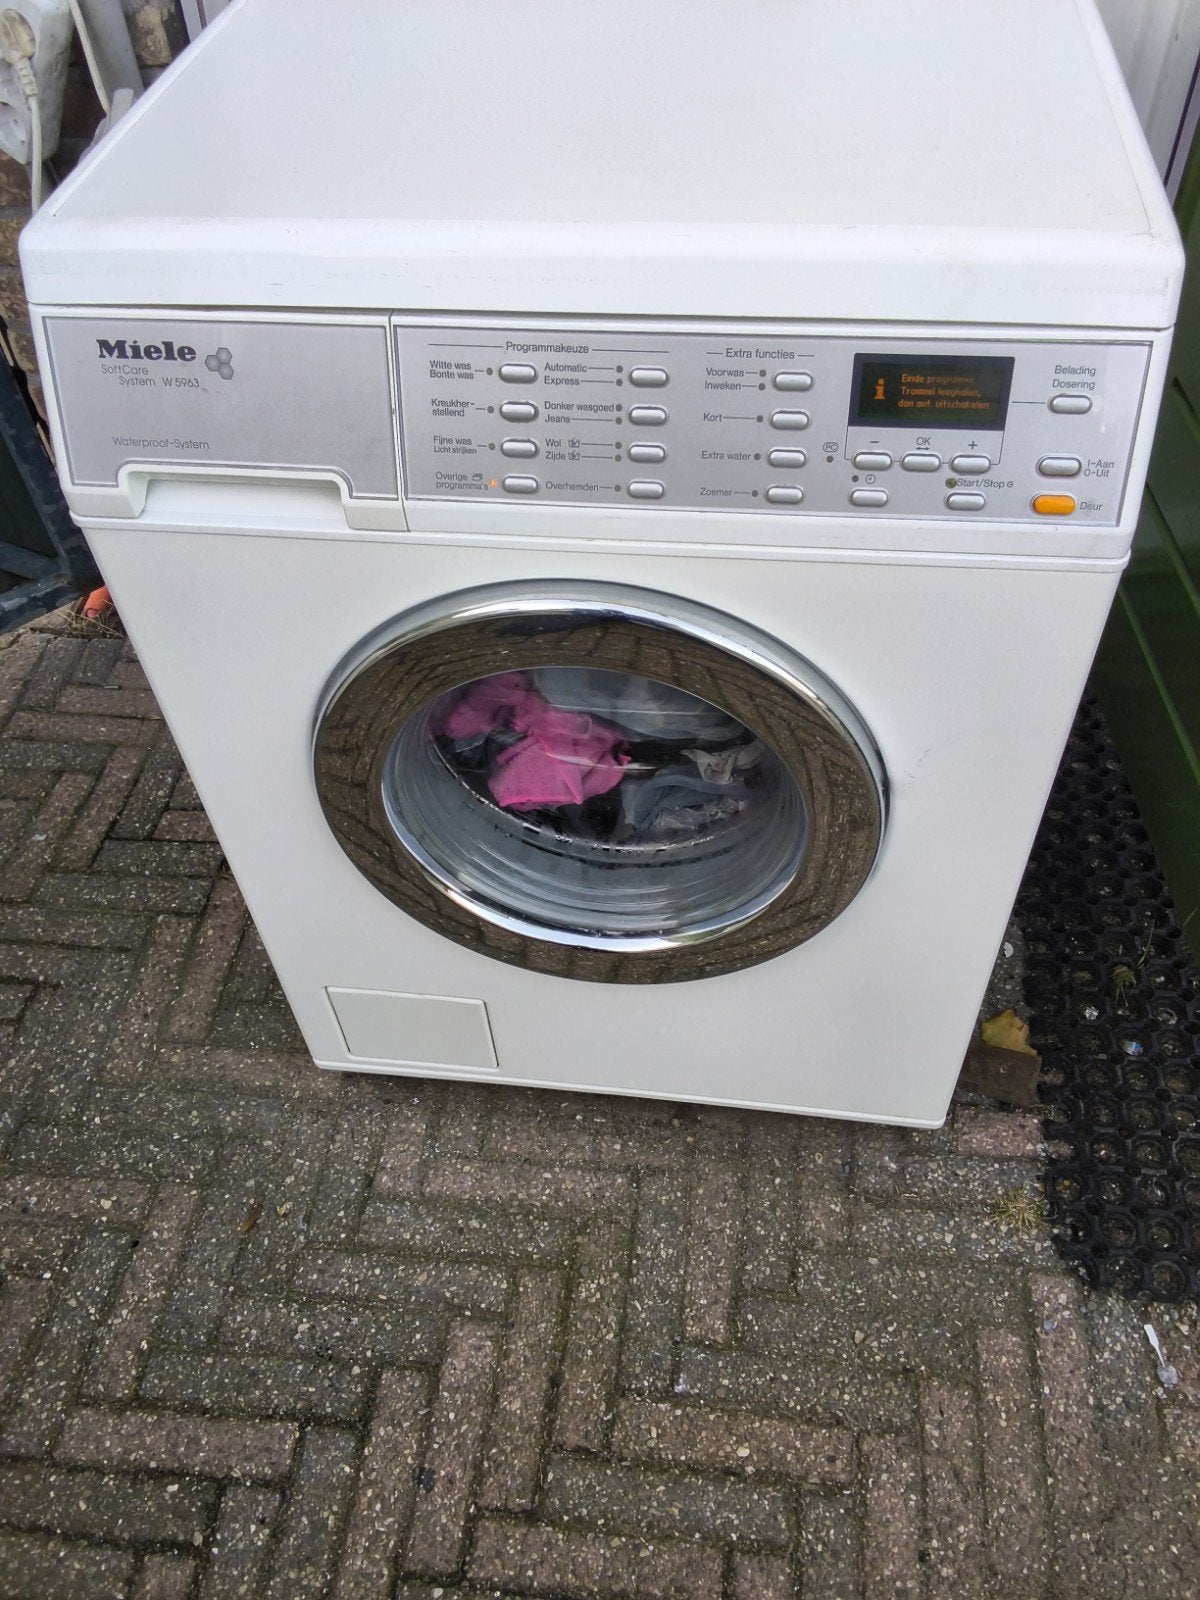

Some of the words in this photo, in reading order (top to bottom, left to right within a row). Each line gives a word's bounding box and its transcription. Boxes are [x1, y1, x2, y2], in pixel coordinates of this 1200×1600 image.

[96, 339, 197, 362] Miele
[506, 342, 589, 354] Programmakeuze
[725, 348, 752, 358] Extra
[756, 349, 795, 359] functies
[101, 364, 149, 375] SoftCare
[429, 360, 453, 370] Witte
[544, 363, 588, 373] Automatic
[430, 370, 458, 379] Bonte
[459, 372, 474, 380] was
[706, 367, 744, 377] Voorwas
[1054, 365, 1097, 376] Belading
[119, 376, 156, 387] System
[544, 376, 580, 387] Express
[901, 373, 925, 383] Einde
[704, 381, 742, 391] Inweken
[1052, 379, 1096, 390] Dosering
[432, 408, 465, 417] stellend
[544, 401, 575, 411] Donker
[576, 403, 615, 414] wasgoed
[545, 414, 571, 424] Jeans
[703, 413, 722, 422] Kort
[112, 436, 210, 450] Waterproof-System
[433, 435, 454, 446] Fijne
[545, 438, 562, 448] Wol
[916, 437, 932, 446] OK
[433, 446, 452, 454] Licht
[545, 451, 566, 462] Zijde
[701, 451, 725, 460] Extra
[726, 453, 751, 461] water
[435, 472, 468, 482] Overige
[436, 481, 489, 491] programma's
[545, 482, 599, 493] Overhemden
[956, 479, 1005, 489] Start/Stop
[700, 487, 733, 497] Zoemer
[1079, 501, 1103, 511] Deur
